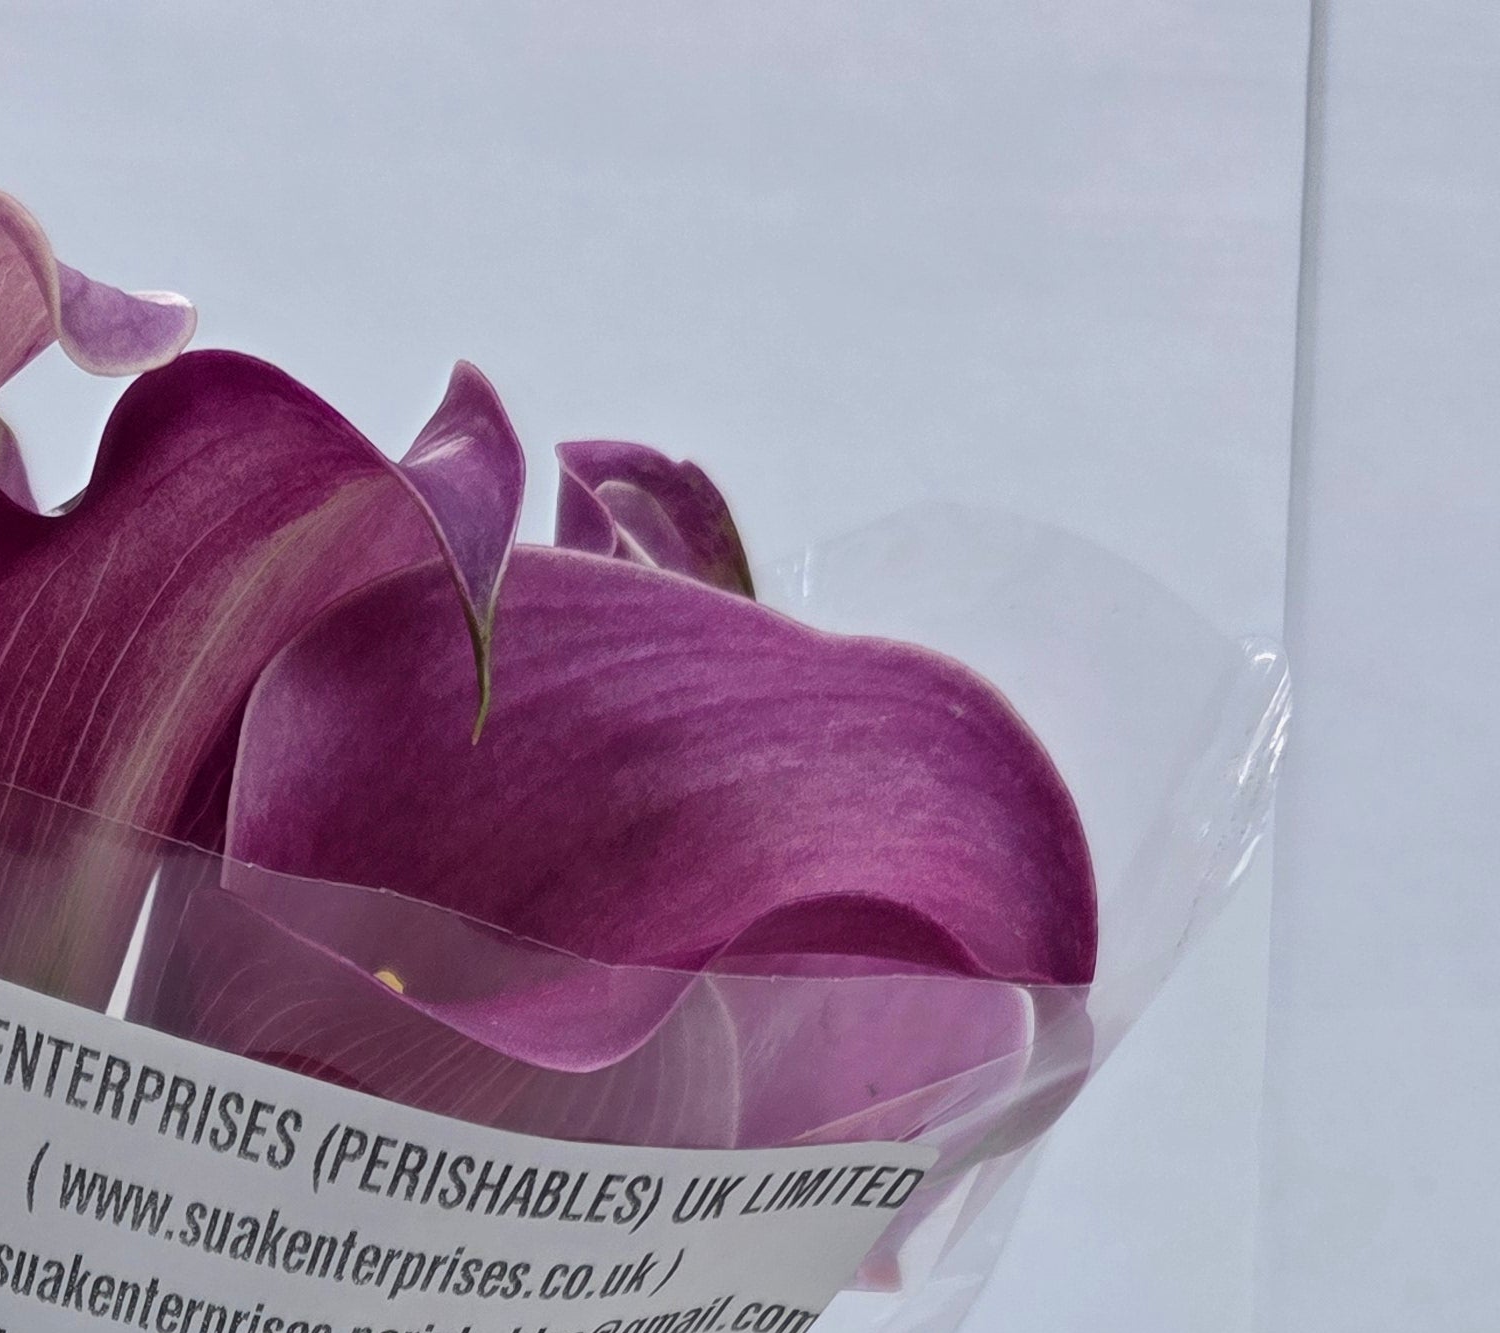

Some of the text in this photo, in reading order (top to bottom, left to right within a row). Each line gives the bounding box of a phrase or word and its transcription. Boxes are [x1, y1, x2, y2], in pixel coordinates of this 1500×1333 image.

[313, 1123, 663, 1234] (PERISHABLES)
[672, 1176, 746, 1223] UK
[740, 1166, 925, 1215] LIMITED
